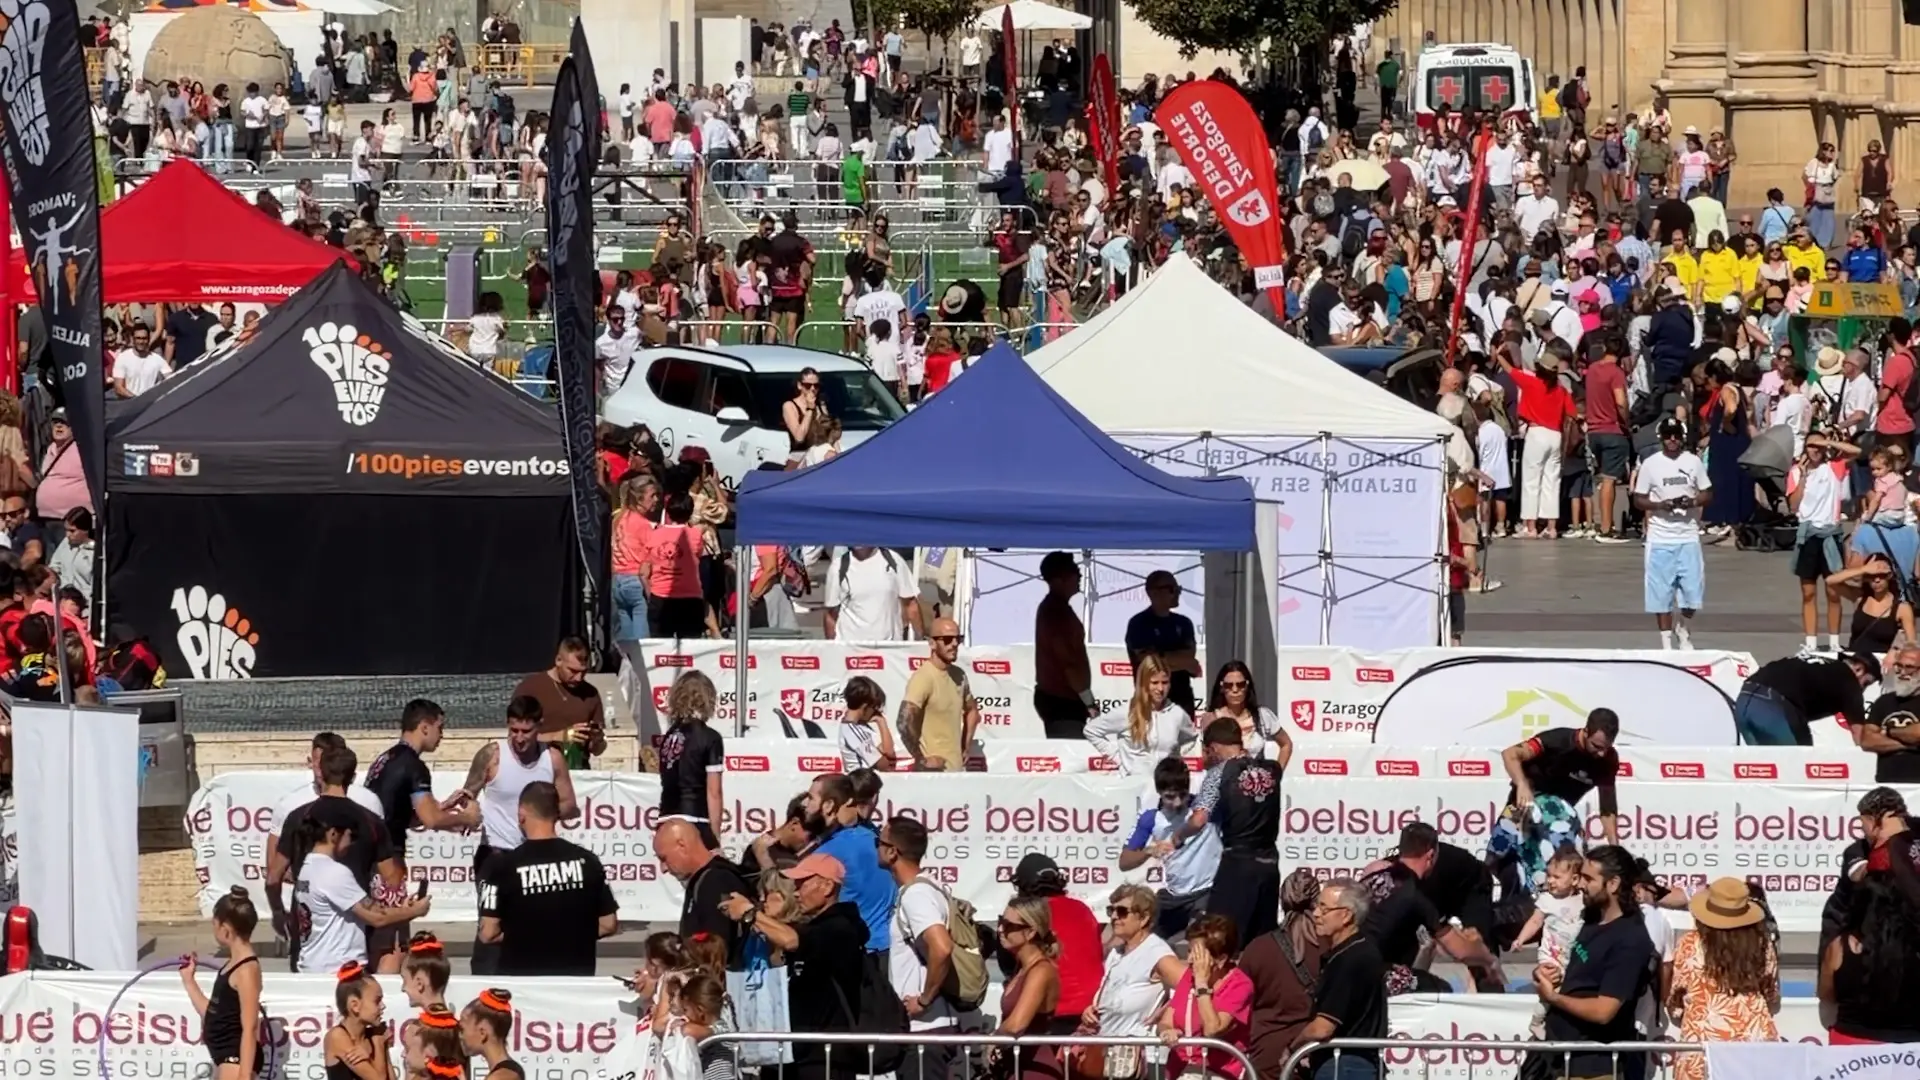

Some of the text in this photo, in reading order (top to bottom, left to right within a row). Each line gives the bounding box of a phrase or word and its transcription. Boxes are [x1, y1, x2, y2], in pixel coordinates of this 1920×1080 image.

[1437, 57, 1505, 66] AMBULANCIA
[309, 342, 391, 386] PIES
[346, 452, 571, 479] /100pieseventos
[1322, 700, 1383, 718] Zarago
[1322, 717, 1376, 732] DEPOR
[986, 794, 1120, 834] belsué
[1285, 845, 1379, 861] SEGUR
[1735, 853, 1844, 869] SEGURO
[516, 858, 584, 890] TATAMI
[73, 1002, 204, 1046] belsu
[513, 1009, 618, 1054] lsué
[1385, 1021, 1522, 1065] belsu
[72, 1059, 214, 1079] SEGURO
